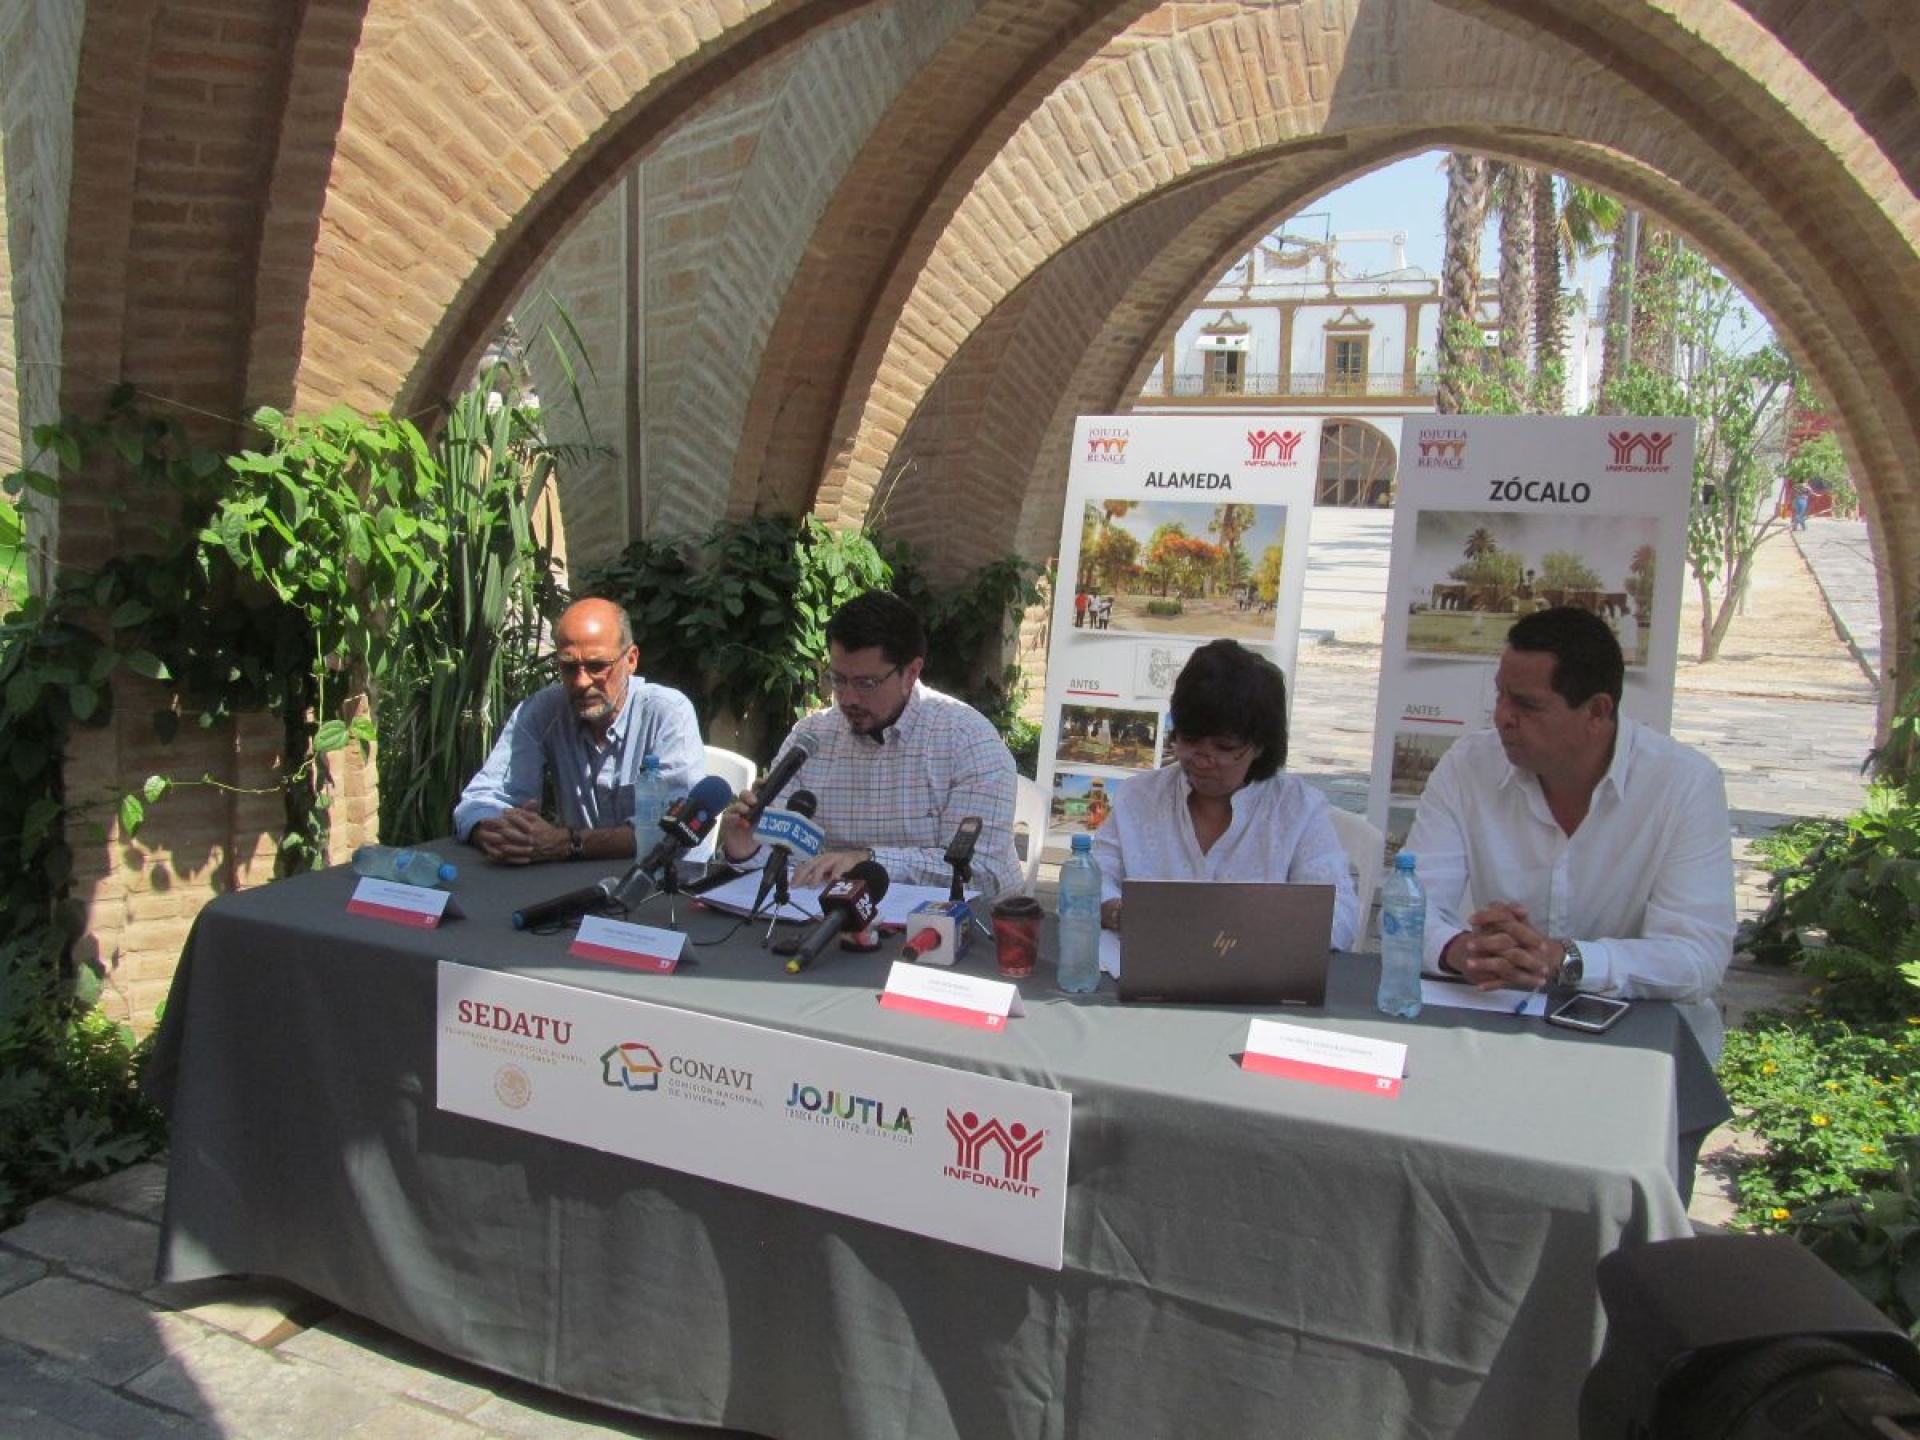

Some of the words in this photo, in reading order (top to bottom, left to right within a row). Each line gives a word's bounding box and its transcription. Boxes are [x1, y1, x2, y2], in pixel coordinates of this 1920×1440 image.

[1244, 460, 1299, 468] INFONAVIT
[1605, 464, 1670, 473] INFONAVIT
[1145, 471, 1233, 490] ALAMEDA
[1488, 476, 1591, 503] ZÓCALO
[1069, 678, 1100, 690] ANTES
[1405, 703, 1441, 717] ANTES
[458, 999, 574, 1045] SEDATU
[669, 1056, 754, 1090] CONAVI
[786, 1082, 914, 1135] JOJUTLA
[943, 1165, 1041, 1199] INFONAVIT
